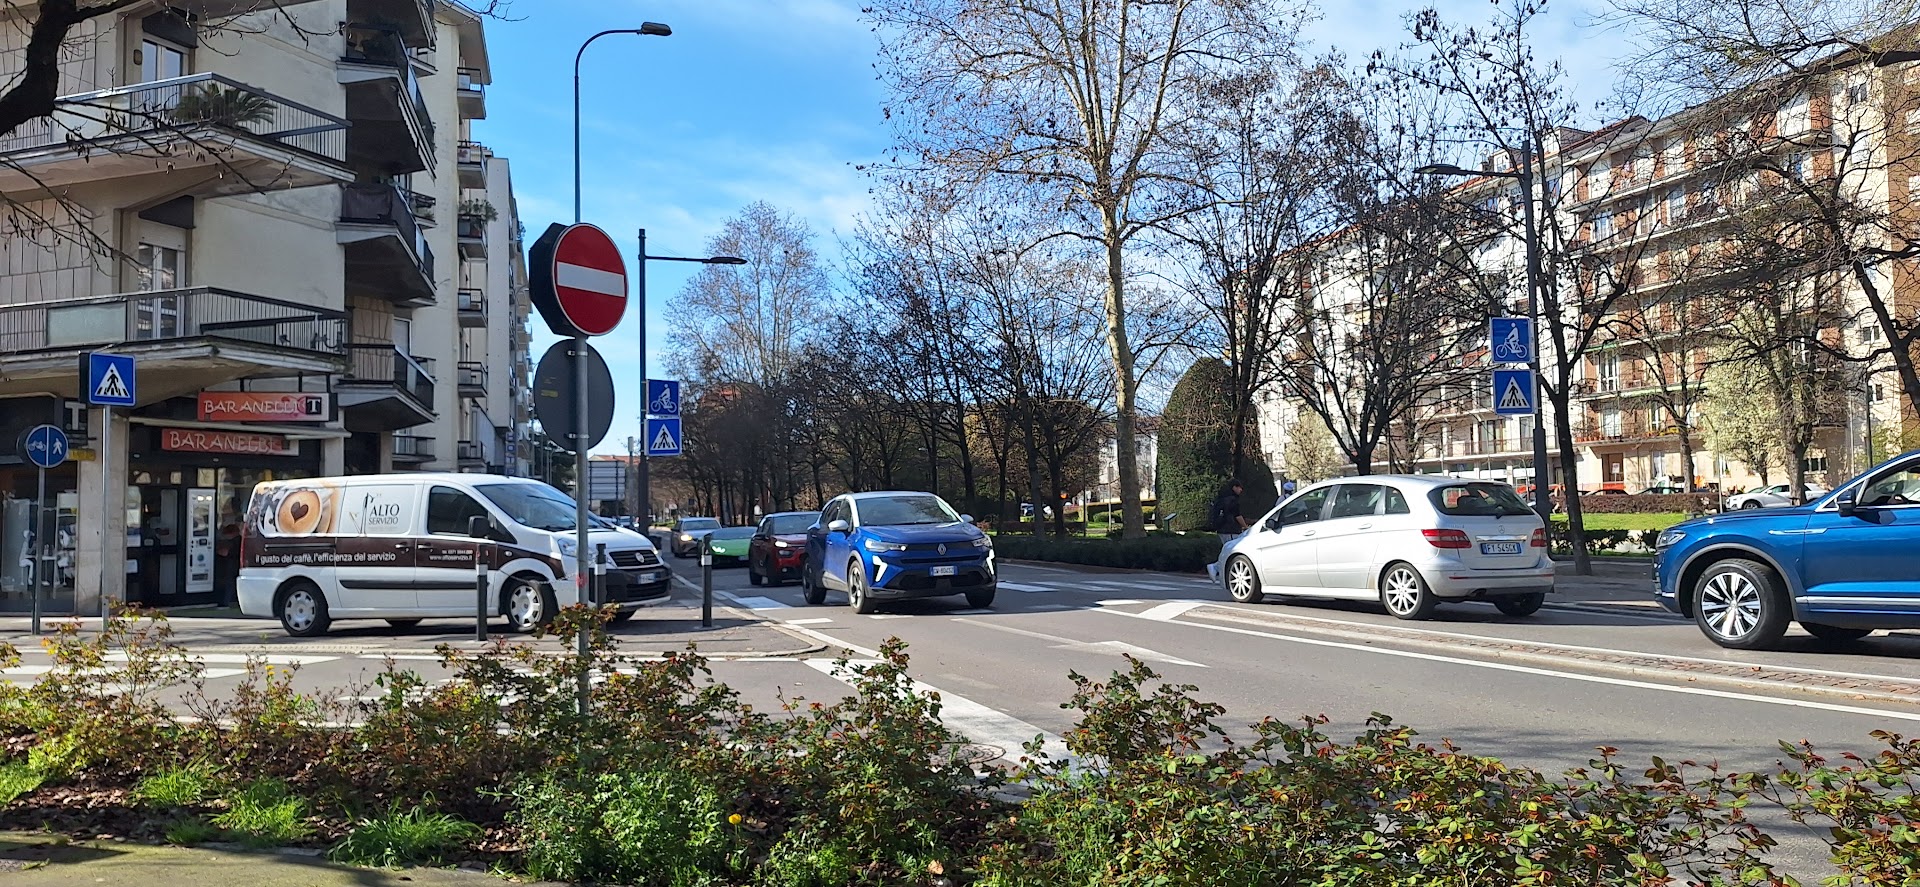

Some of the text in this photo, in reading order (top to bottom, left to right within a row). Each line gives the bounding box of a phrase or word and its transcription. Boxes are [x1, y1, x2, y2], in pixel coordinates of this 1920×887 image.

[307, 398, 320, 413] T
[65, 401, 86, 430] T
[370, 503, 400, 517] ALTO
[368, 516, 399, 525] SERVIZIO
[260, 554, 280, 565] gusto
[281, 554, 292, 563] del
[353, 552, 366, 562] del
[367, 552, 396, 561] servizio
